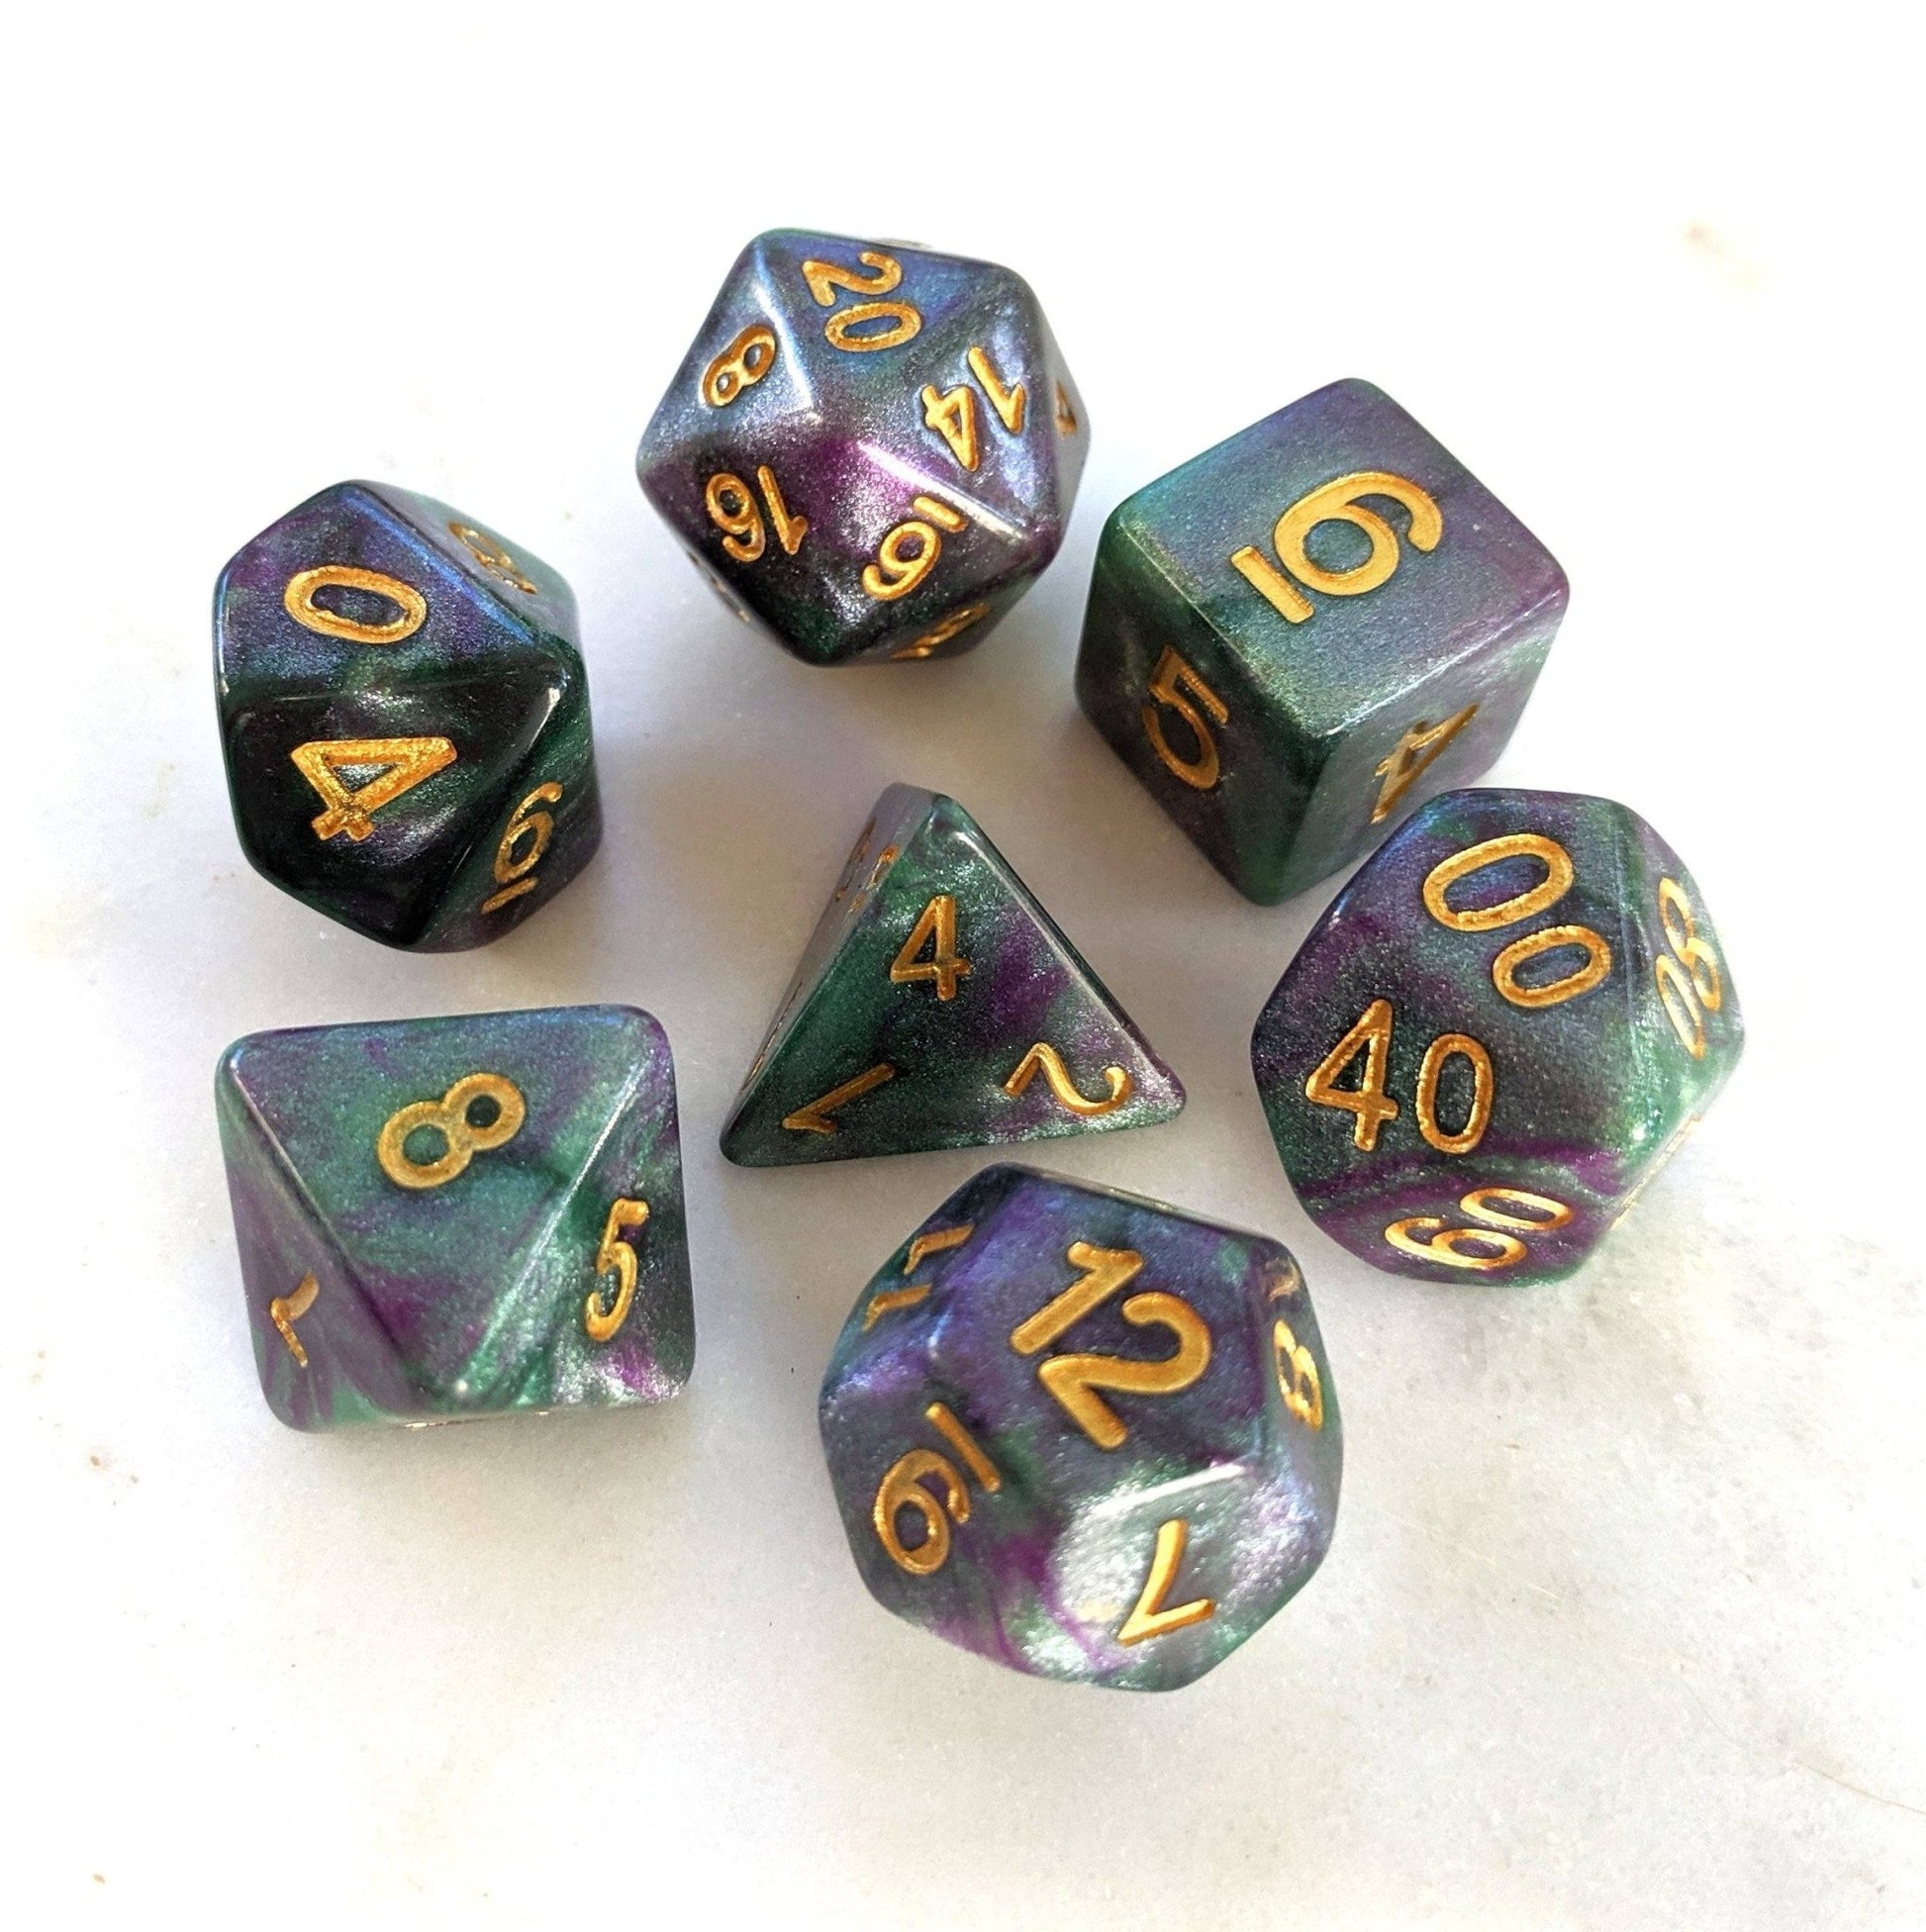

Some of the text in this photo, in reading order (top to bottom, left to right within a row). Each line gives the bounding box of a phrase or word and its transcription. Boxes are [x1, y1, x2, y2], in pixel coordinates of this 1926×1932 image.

[802, 249, 922, 353] 20
[702, 324, 778, 407] 8
[920, 344, 1026, 473] 14
[705, 465, 810, 564] 16
[1230, 469, 1445, 623] 6
[283, 564, 428, 645] 0
[1141, 643, 1230, 792] 5
[1370, 702, 1480, 825] 4
[290, 735, 459, 843] 4
[481, 780, 564, 916] 6
[890, 893, 973, 1003] 4
[1422, 832, 1614, 1010] 00
[376, 1072, 528, 1191] 8
[782, 1062, 897, 1136] 1
[1003, 1041, 1135, 1118] 2
[1304, 999, 1495, 1156] 40
[584, 1197, 651, 1343] 5
[862, 1223, 976, 1334] 11
[1385, 1187, 1576, 1272] 60
[1010, 1240, 1213, 1451] 12
